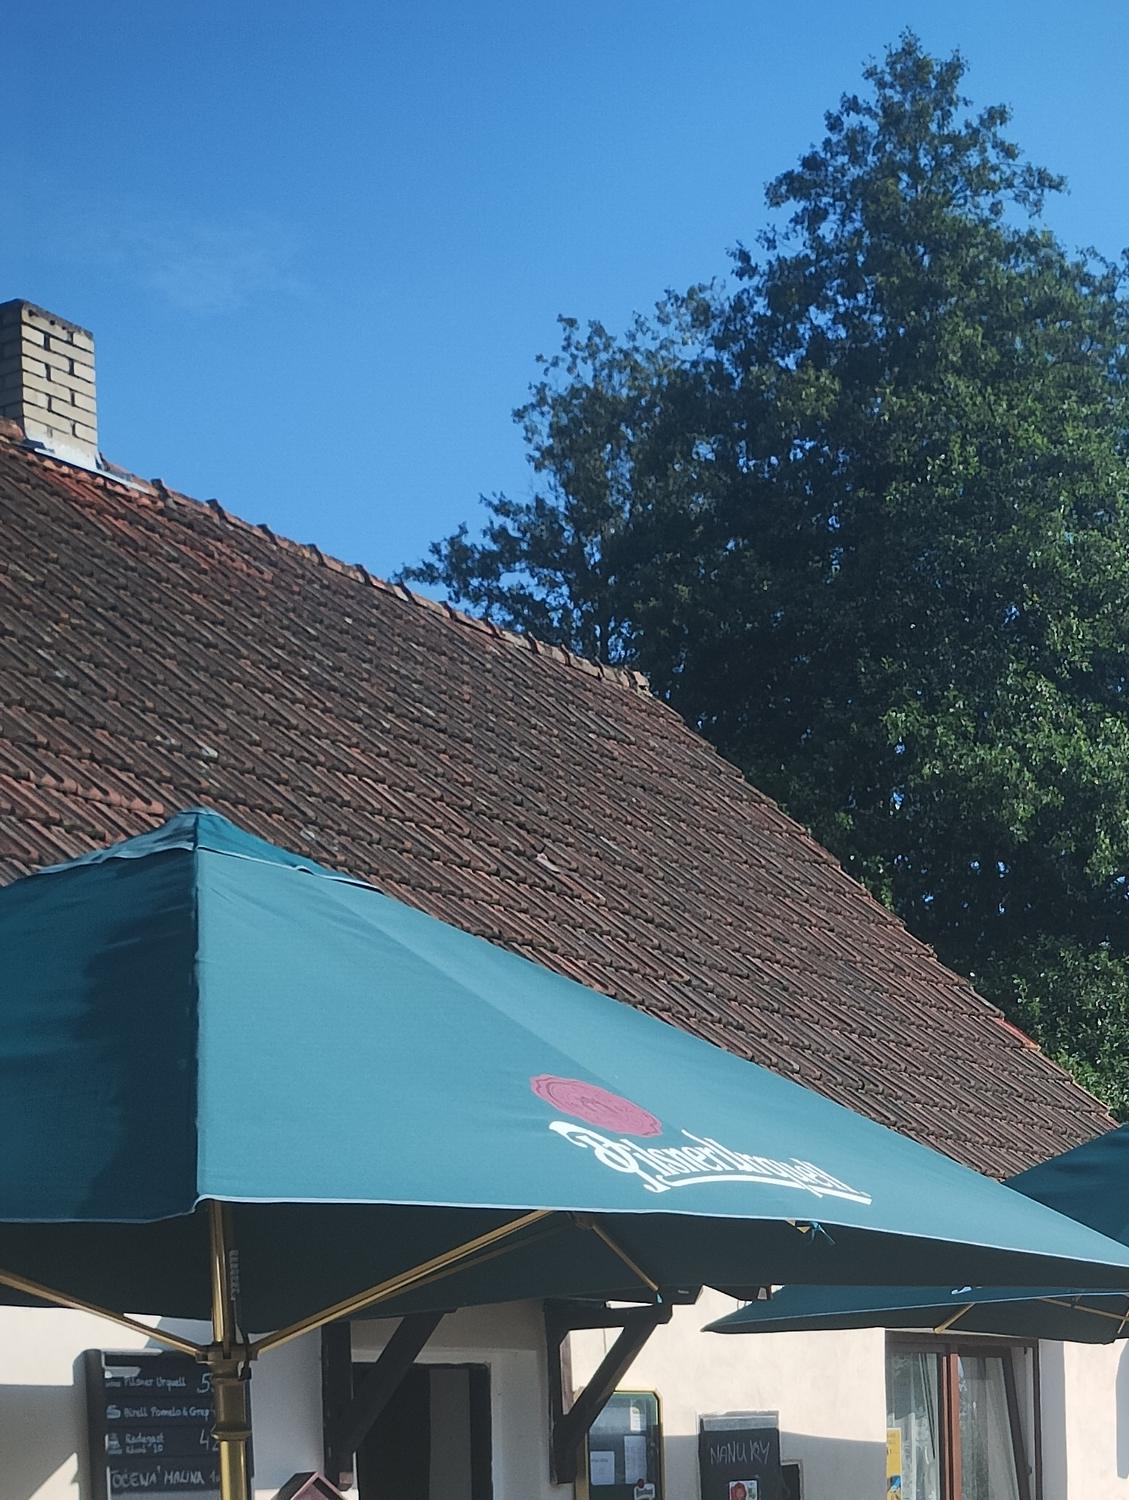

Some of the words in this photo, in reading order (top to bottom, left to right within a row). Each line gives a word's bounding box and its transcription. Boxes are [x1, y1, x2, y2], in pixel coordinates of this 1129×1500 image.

[549, 1121, 719, 1193] Pilsner
[681, 1128, 872, 1199] Urquell
[156, 1376, 187, 1392] Urquell
[151, 1406, 181, 1418] Pomelo
[125, 1432, 164, 1447] Radegast
[164, 1469, 205, 1486] MALINA
